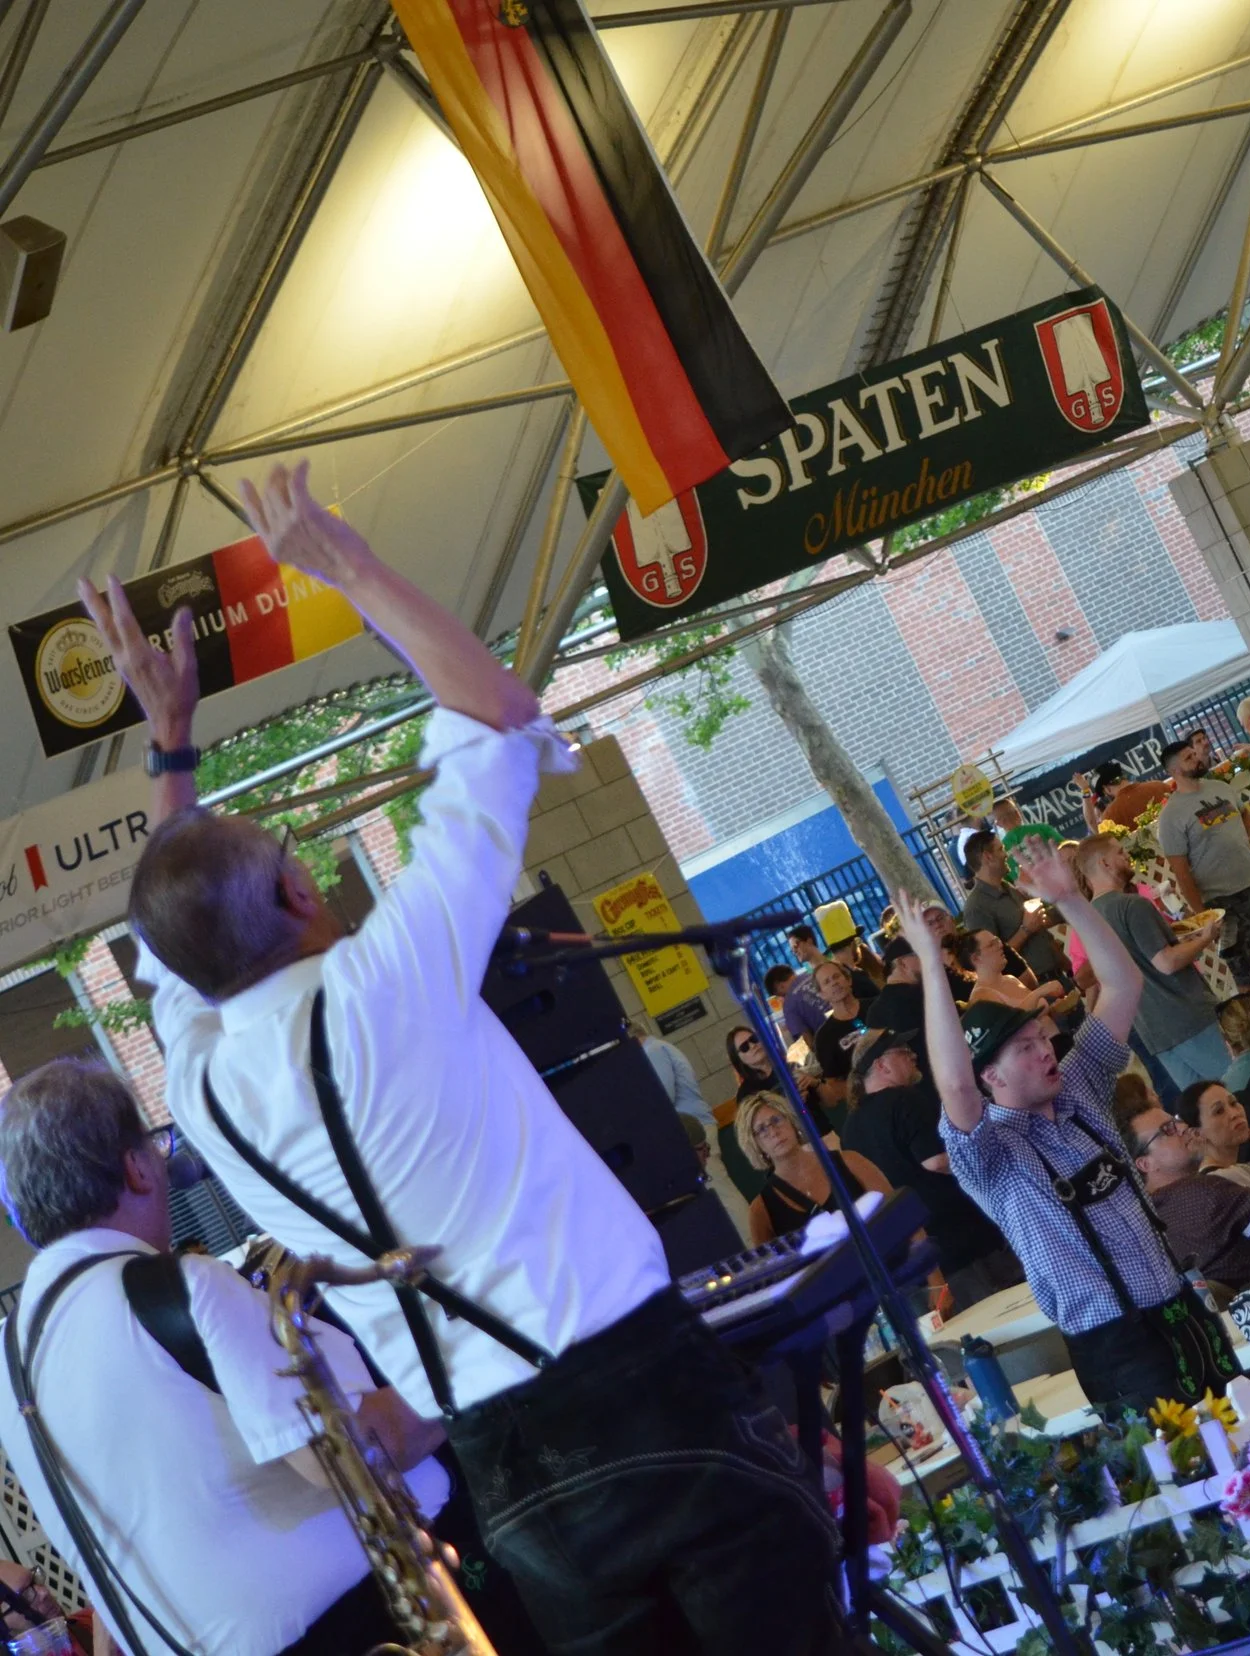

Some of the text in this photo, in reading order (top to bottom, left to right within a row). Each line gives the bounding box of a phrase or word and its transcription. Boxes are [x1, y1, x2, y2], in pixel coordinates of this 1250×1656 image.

[729, 338, 1012, 510] SPATEN
[803, 457, 973, 555] München
[55, 811, 149, 871] ULTR
[41, 881, 95, 917] LIGHT
[97, 865, 139, 892] BEE
